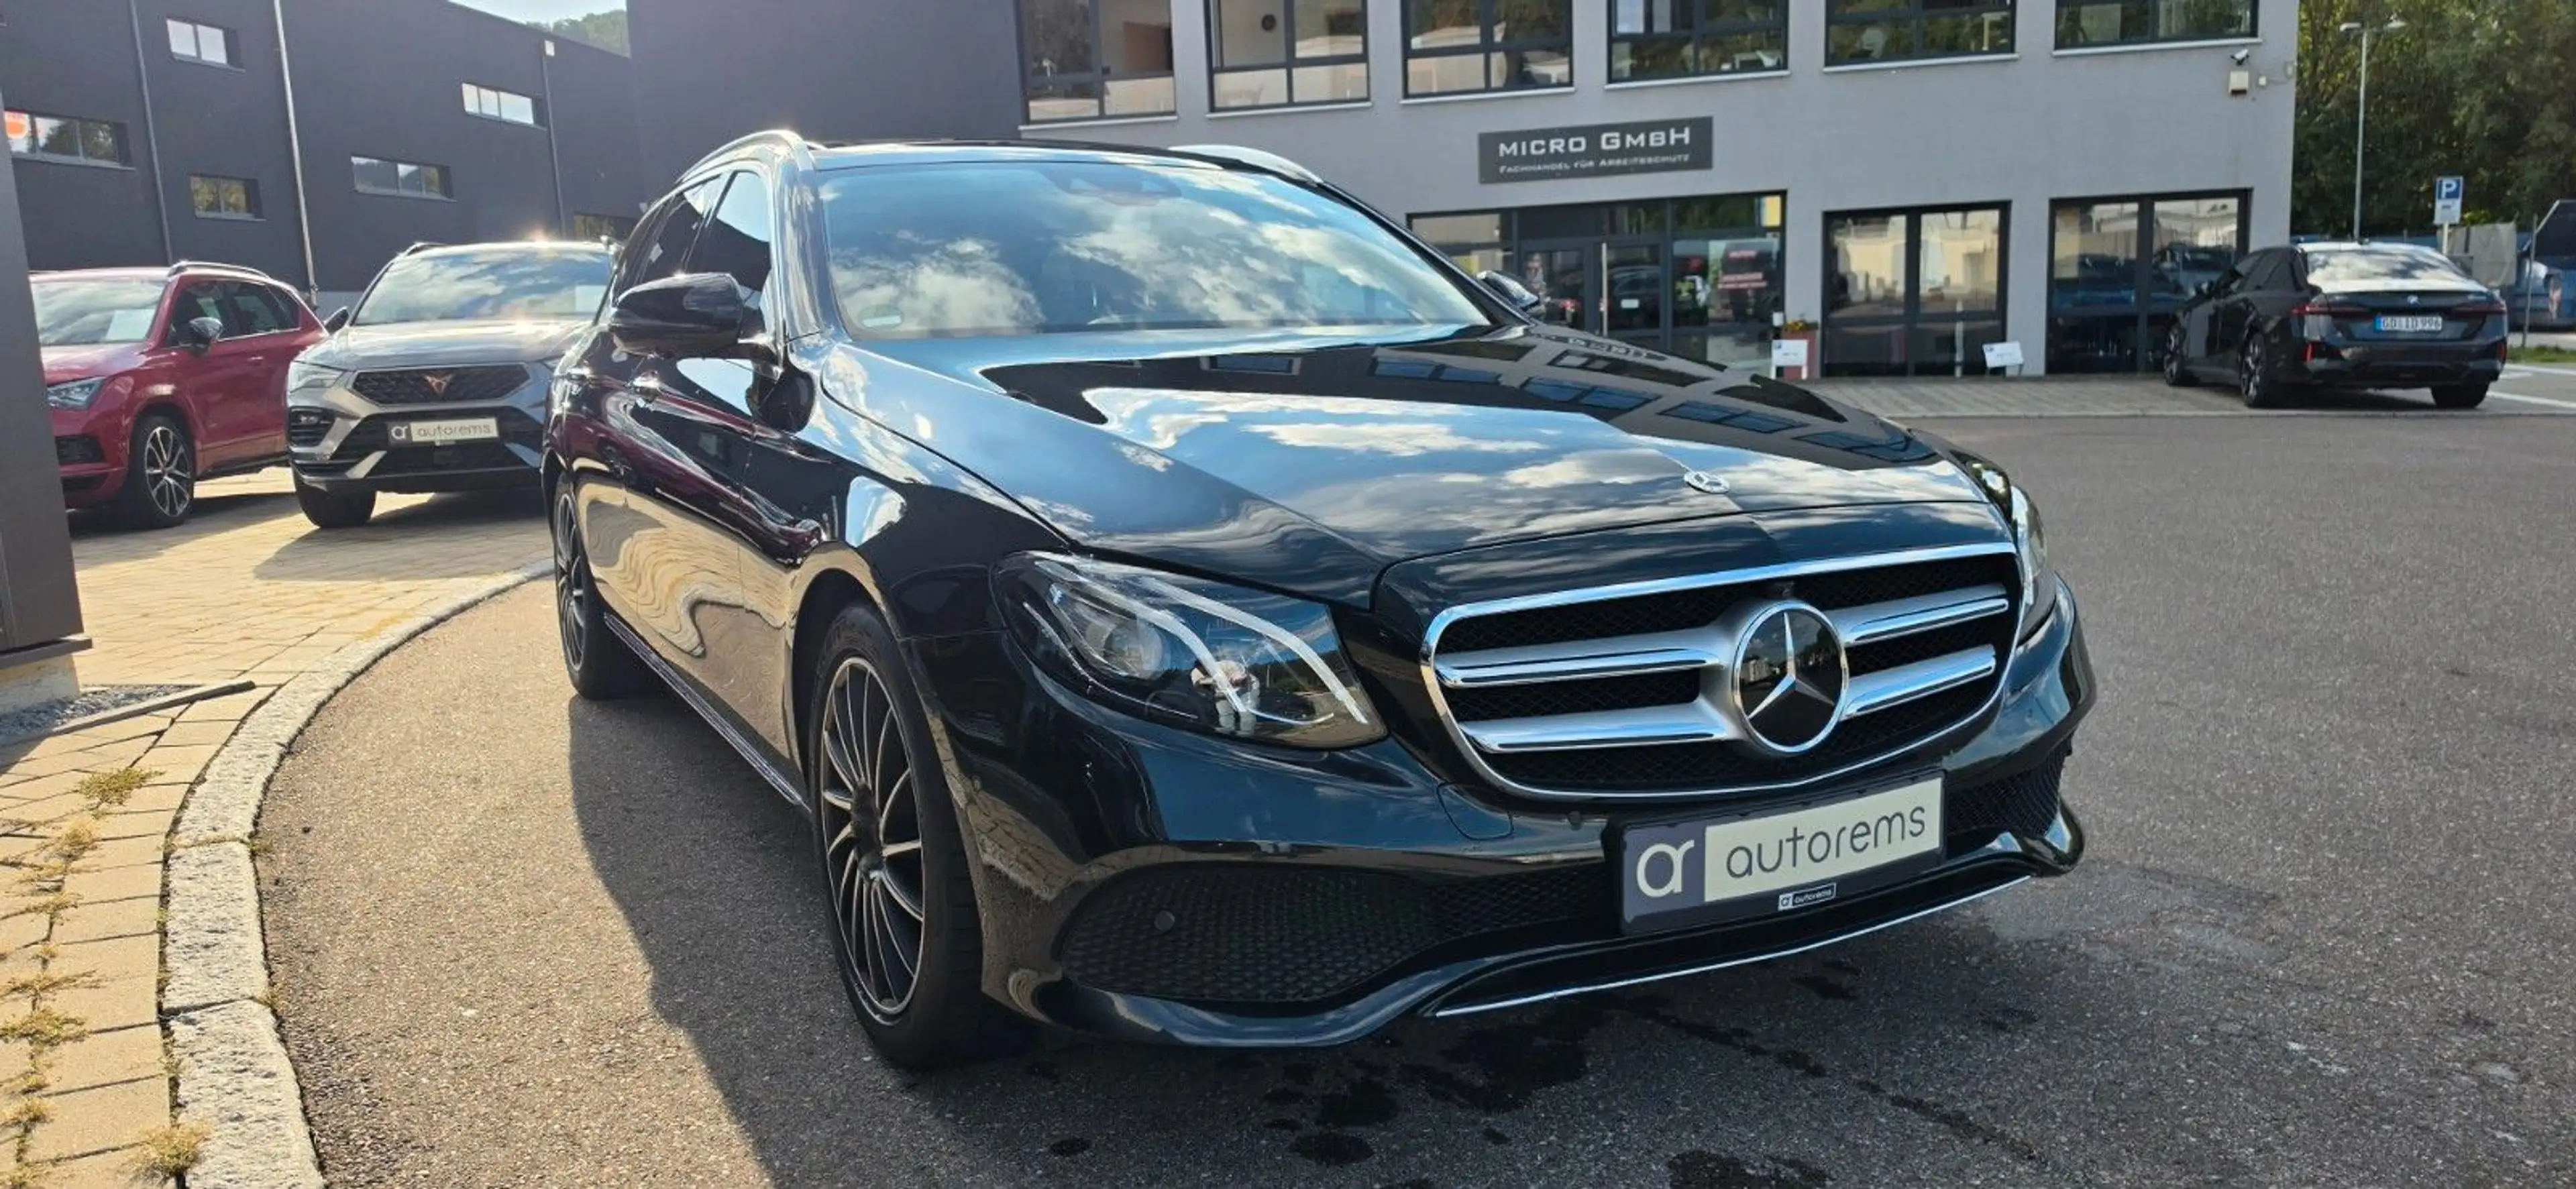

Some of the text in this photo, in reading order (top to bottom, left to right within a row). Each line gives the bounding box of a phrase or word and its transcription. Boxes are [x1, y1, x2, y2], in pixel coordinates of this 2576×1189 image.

[1499, 136, 1587, 157] MICRO
[2441, 179, 2457, 199] P
[417, 424, 491, 437] autorems
[1726, 805, 1926, 879] autorems
[1794, 889, 1831, 904] autorems
